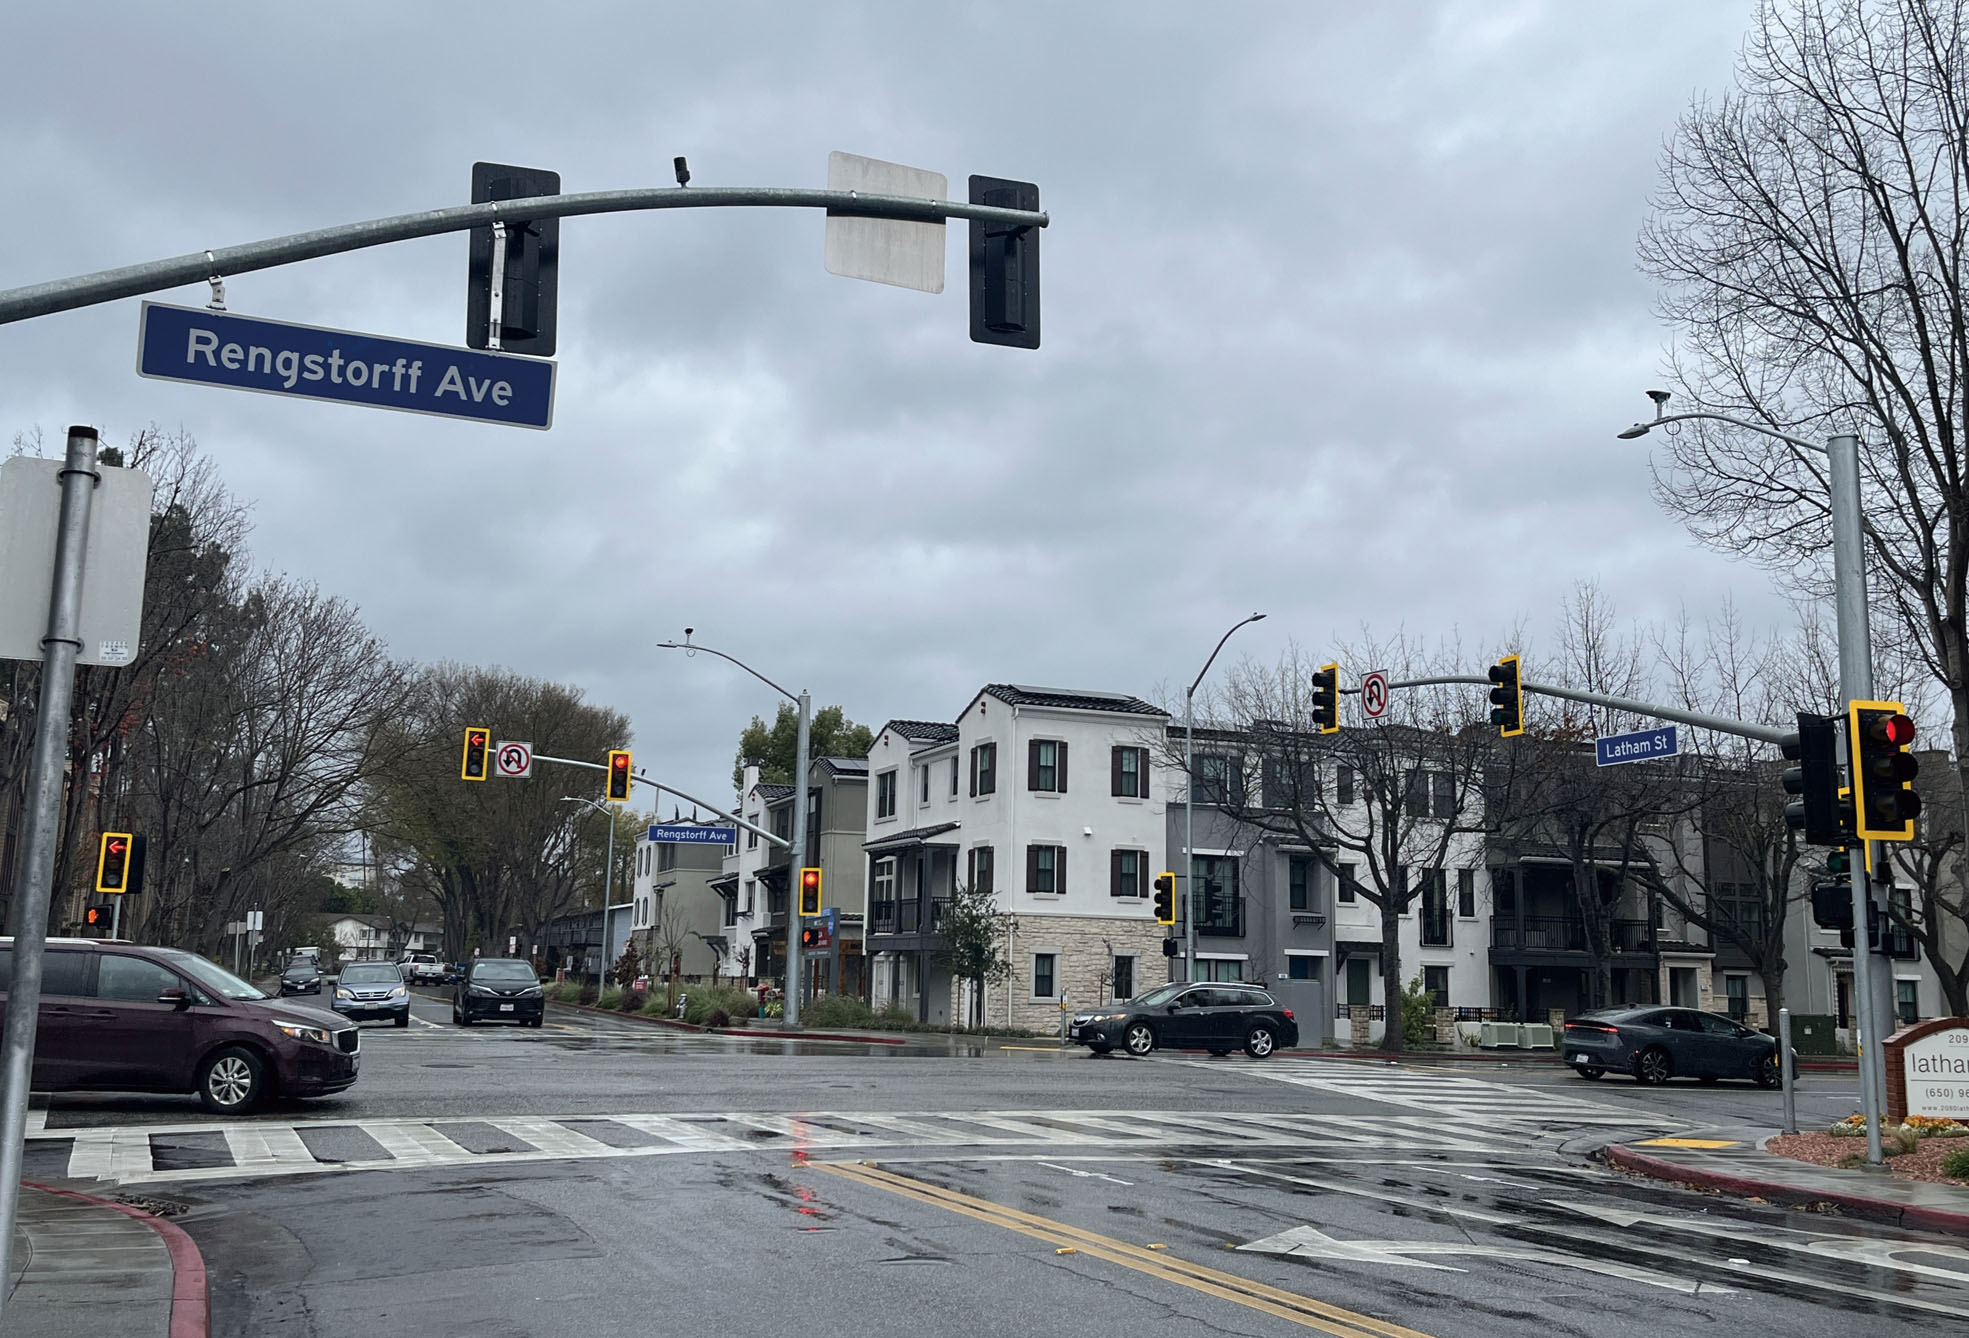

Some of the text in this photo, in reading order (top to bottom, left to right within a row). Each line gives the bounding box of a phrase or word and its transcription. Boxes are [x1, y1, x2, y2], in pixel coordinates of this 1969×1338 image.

[186, 328, 513, 406] Rengstorff Ave
[1606, 734, 1668, 758] Latham St
[656, 829, 728, 841] Rengstorff Ave
[1912, 1053, 1969, 1074] latha
[1925, 1088, 1954, 1099] (650)
